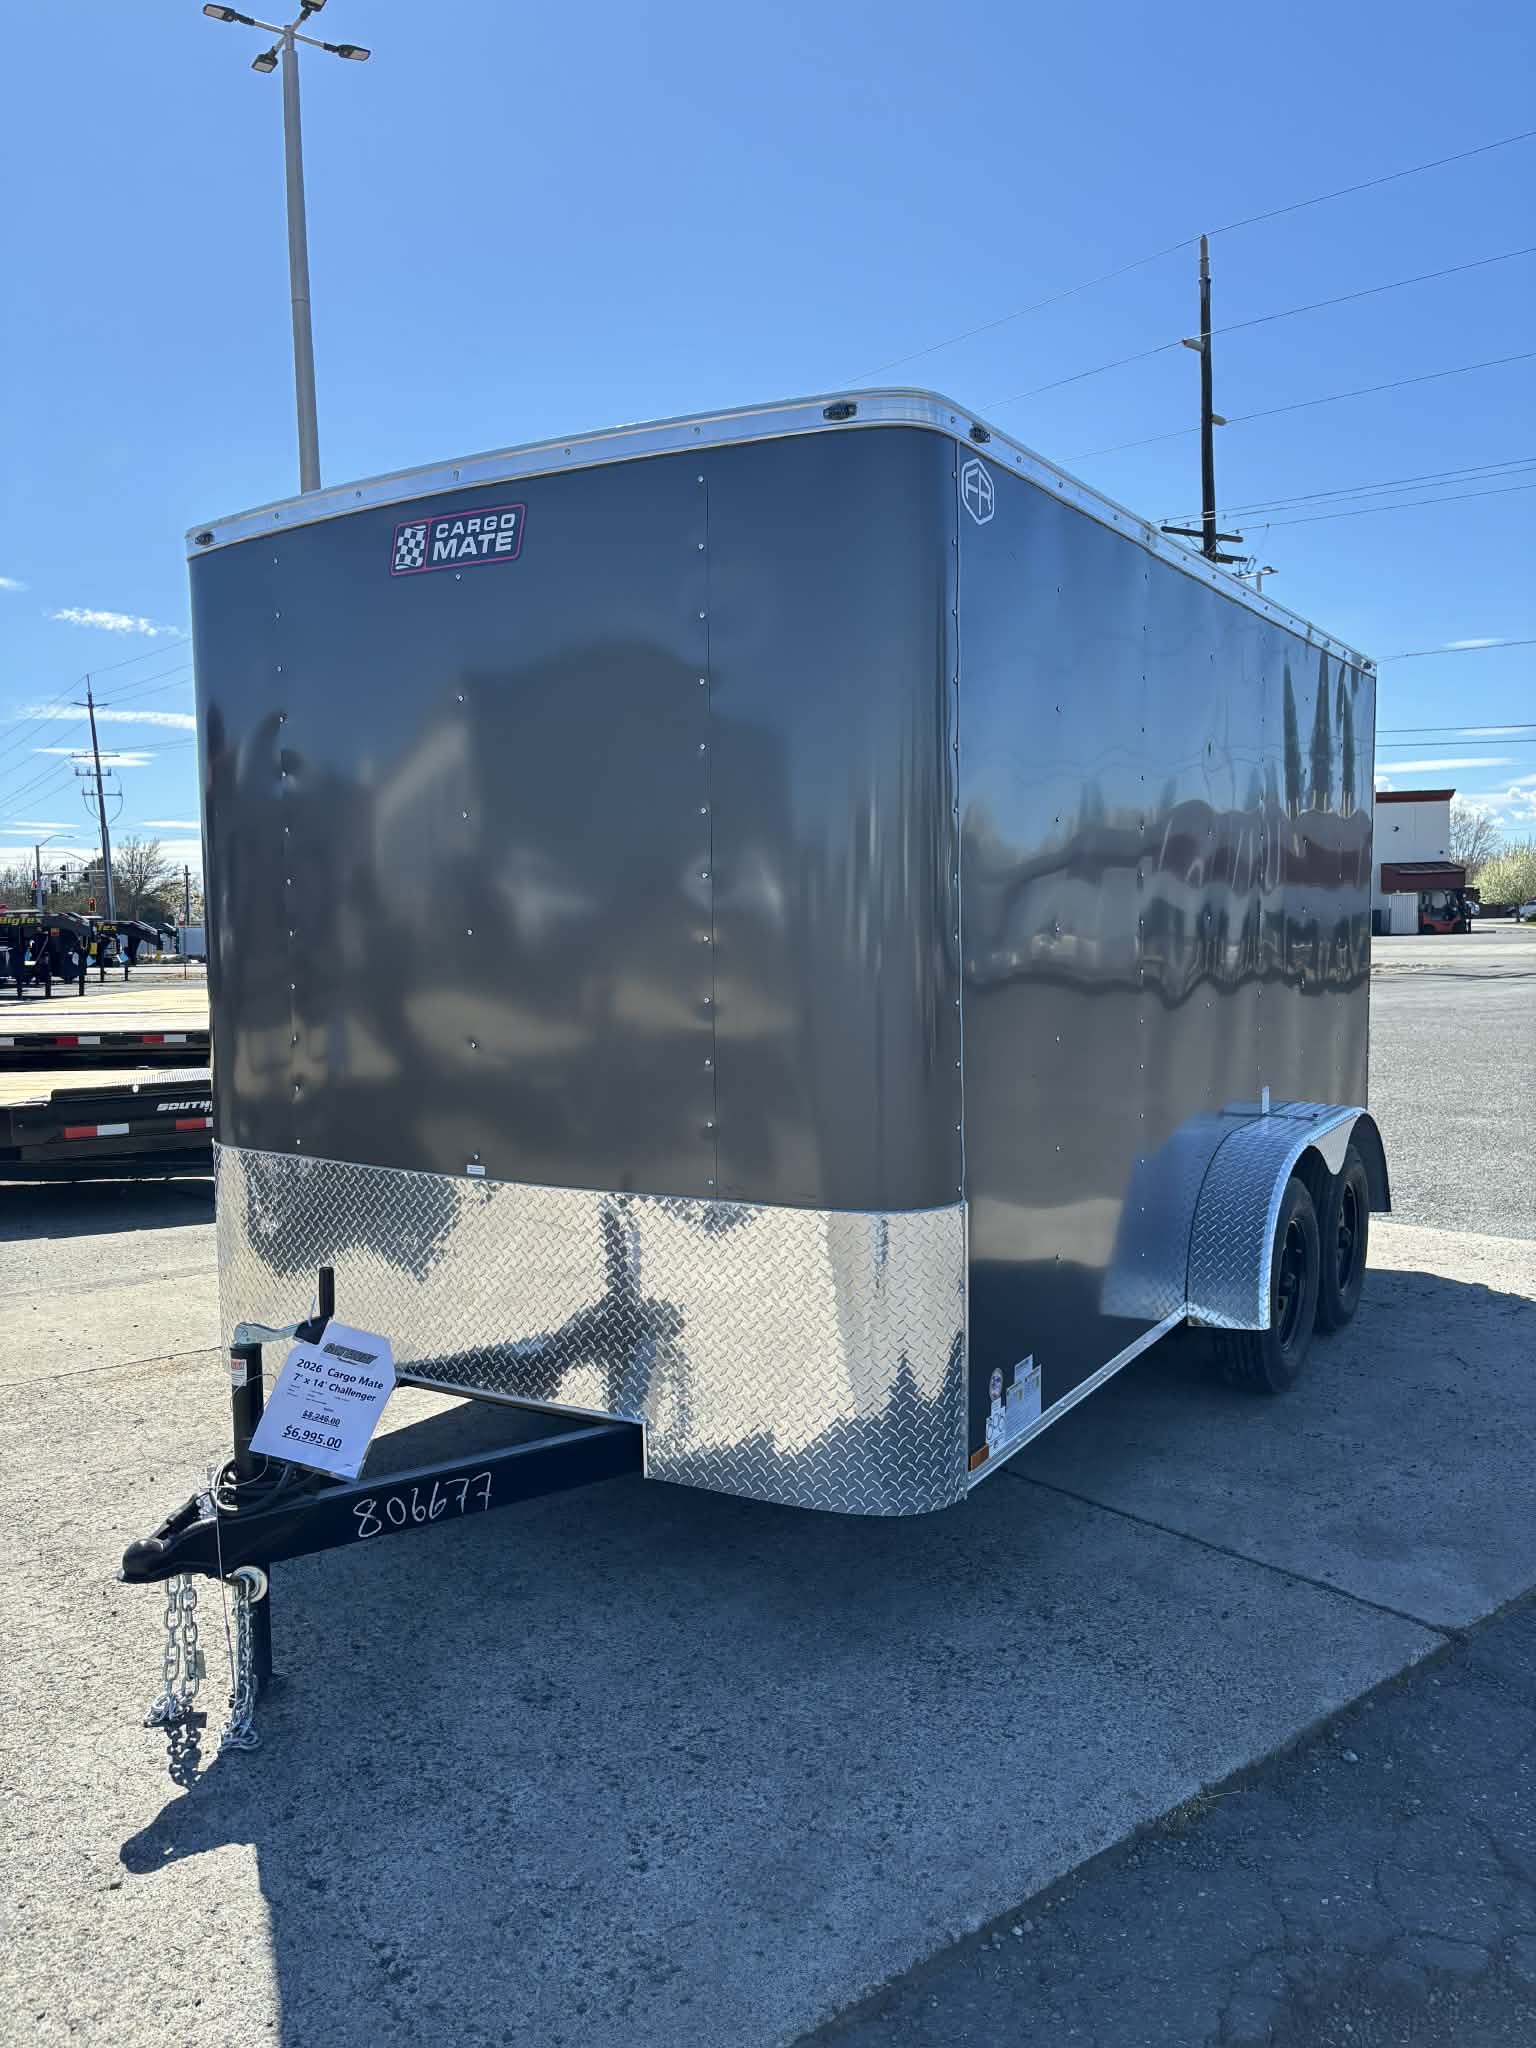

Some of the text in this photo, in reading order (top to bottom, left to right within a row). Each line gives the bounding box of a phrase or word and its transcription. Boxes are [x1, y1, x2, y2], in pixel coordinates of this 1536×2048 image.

[435, 513, 515, 538] CARGO
[432, 530, 514, 560] MATE
[157, 1100, 212, 1111] SOUTH
[296, 1358, 322, 1373] 2026
[327, 1368, 356, 1383] Cargo
[358, 1376, 384, 1390] Mate
[304, 1377, 311, 1385] x
[328, 1383, 376, 1402] Challenger
[283, 1424, 343, 1450] $6,995.00
[353, 1472, 492, 1538] 806677
